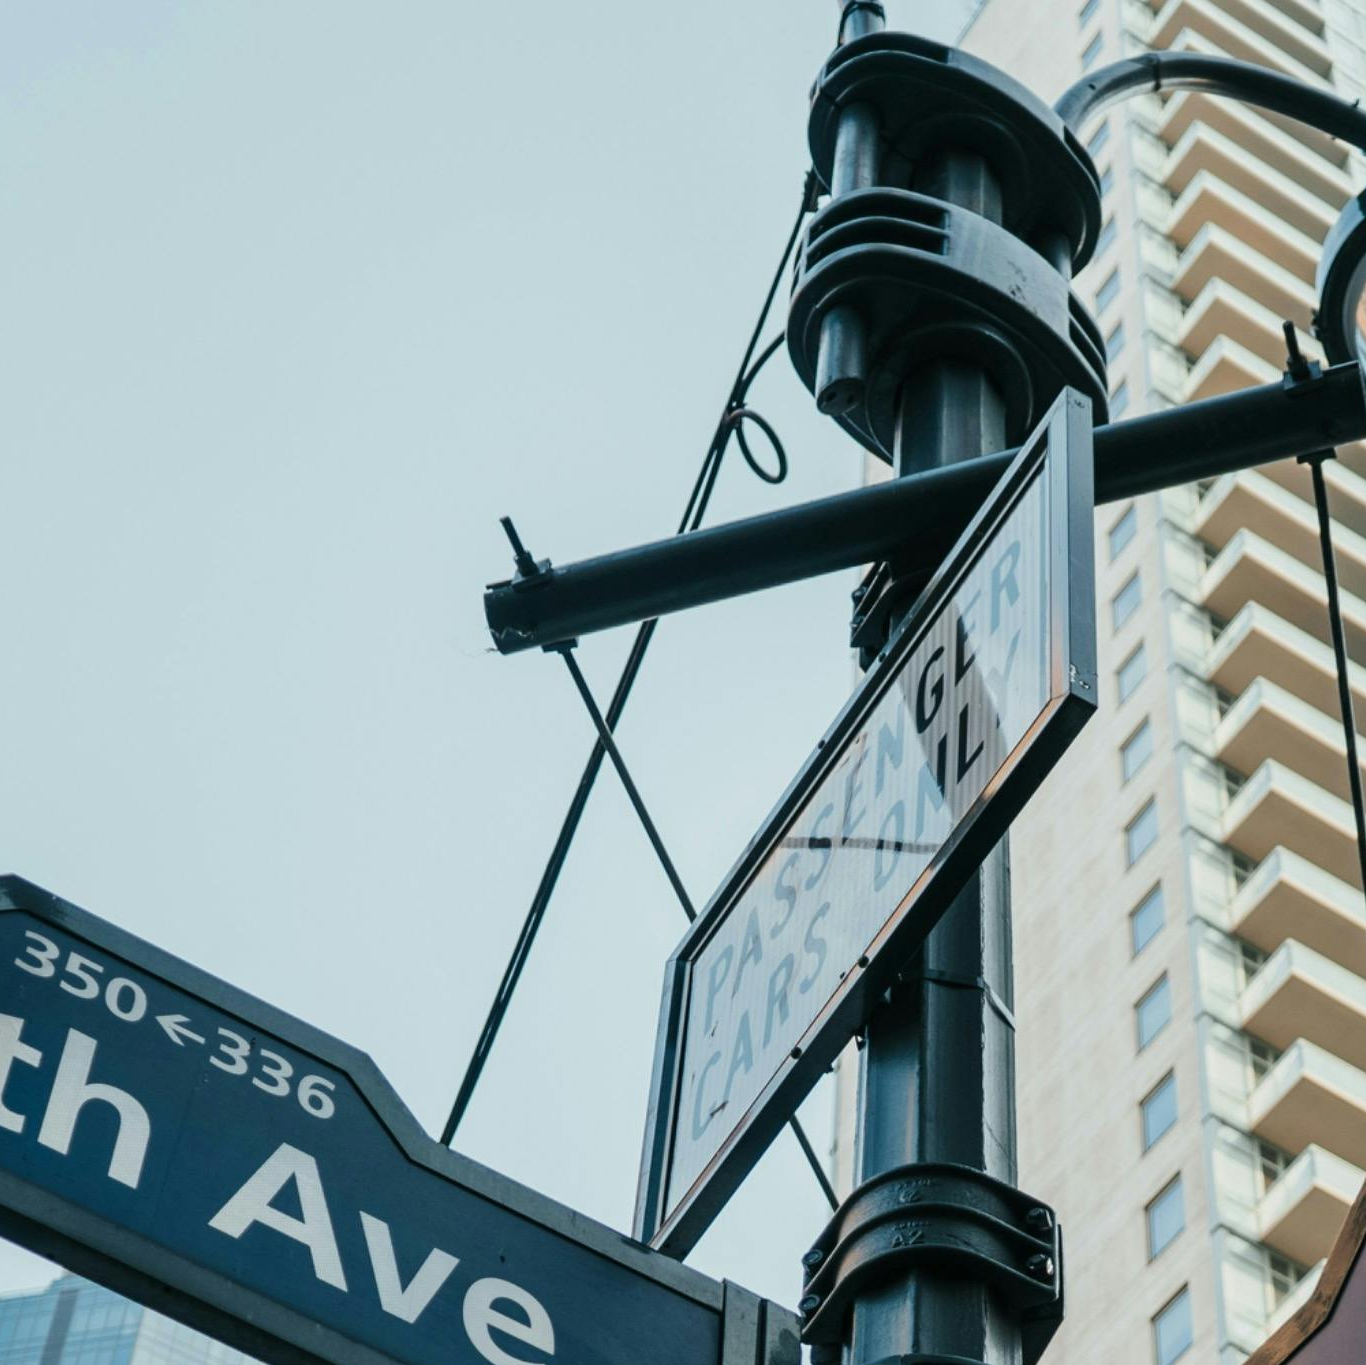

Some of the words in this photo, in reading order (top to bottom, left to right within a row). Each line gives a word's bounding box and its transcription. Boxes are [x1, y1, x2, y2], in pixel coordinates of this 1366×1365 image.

[704, 540, 1021, 1036] PASSENGER
[14, 930, 148, 1022] 350
[209, 1028, 337, 1120] 336
[691, 902, 830, 1141] CARS
